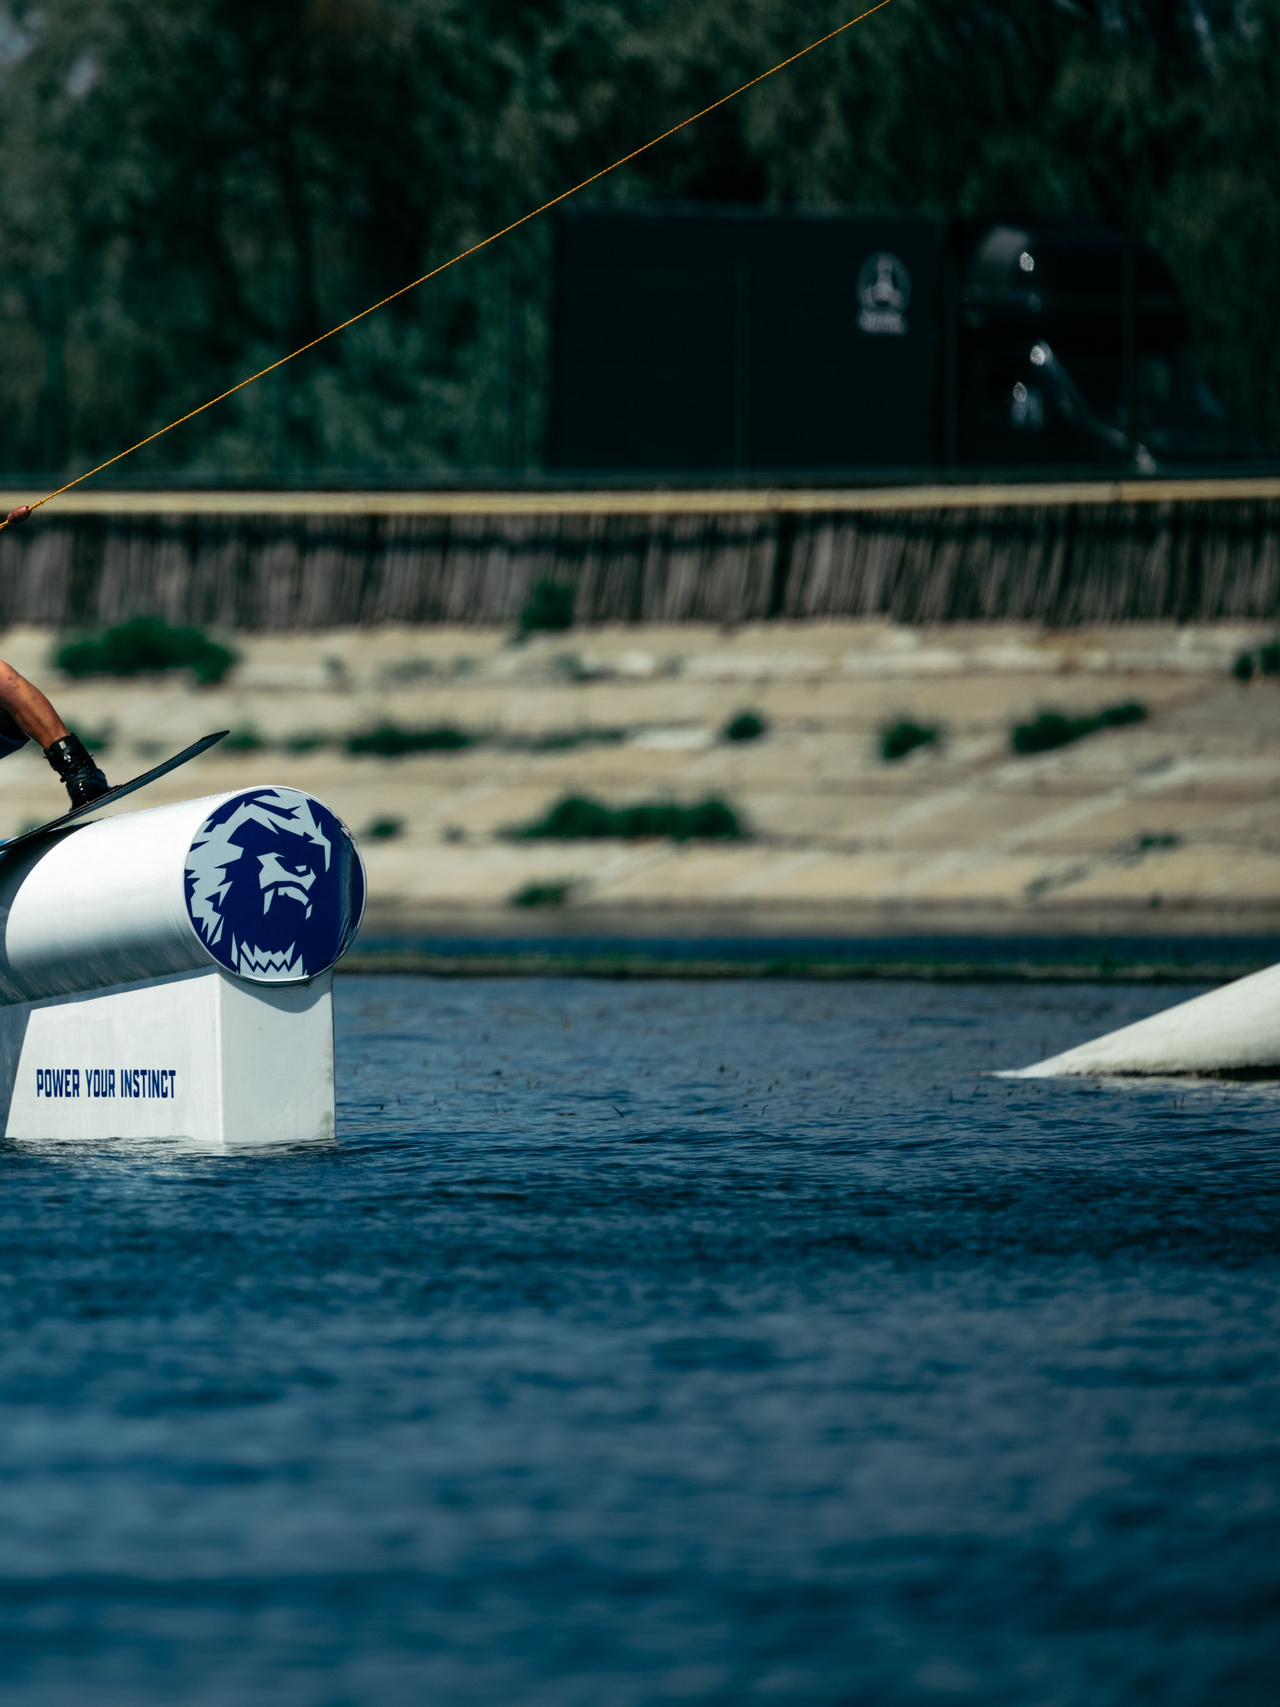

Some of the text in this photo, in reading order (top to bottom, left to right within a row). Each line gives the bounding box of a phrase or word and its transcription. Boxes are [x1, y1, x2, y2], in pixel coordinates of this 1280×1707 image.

[36, 1069, 176, 1099] POWER YOUR INSTINCT
